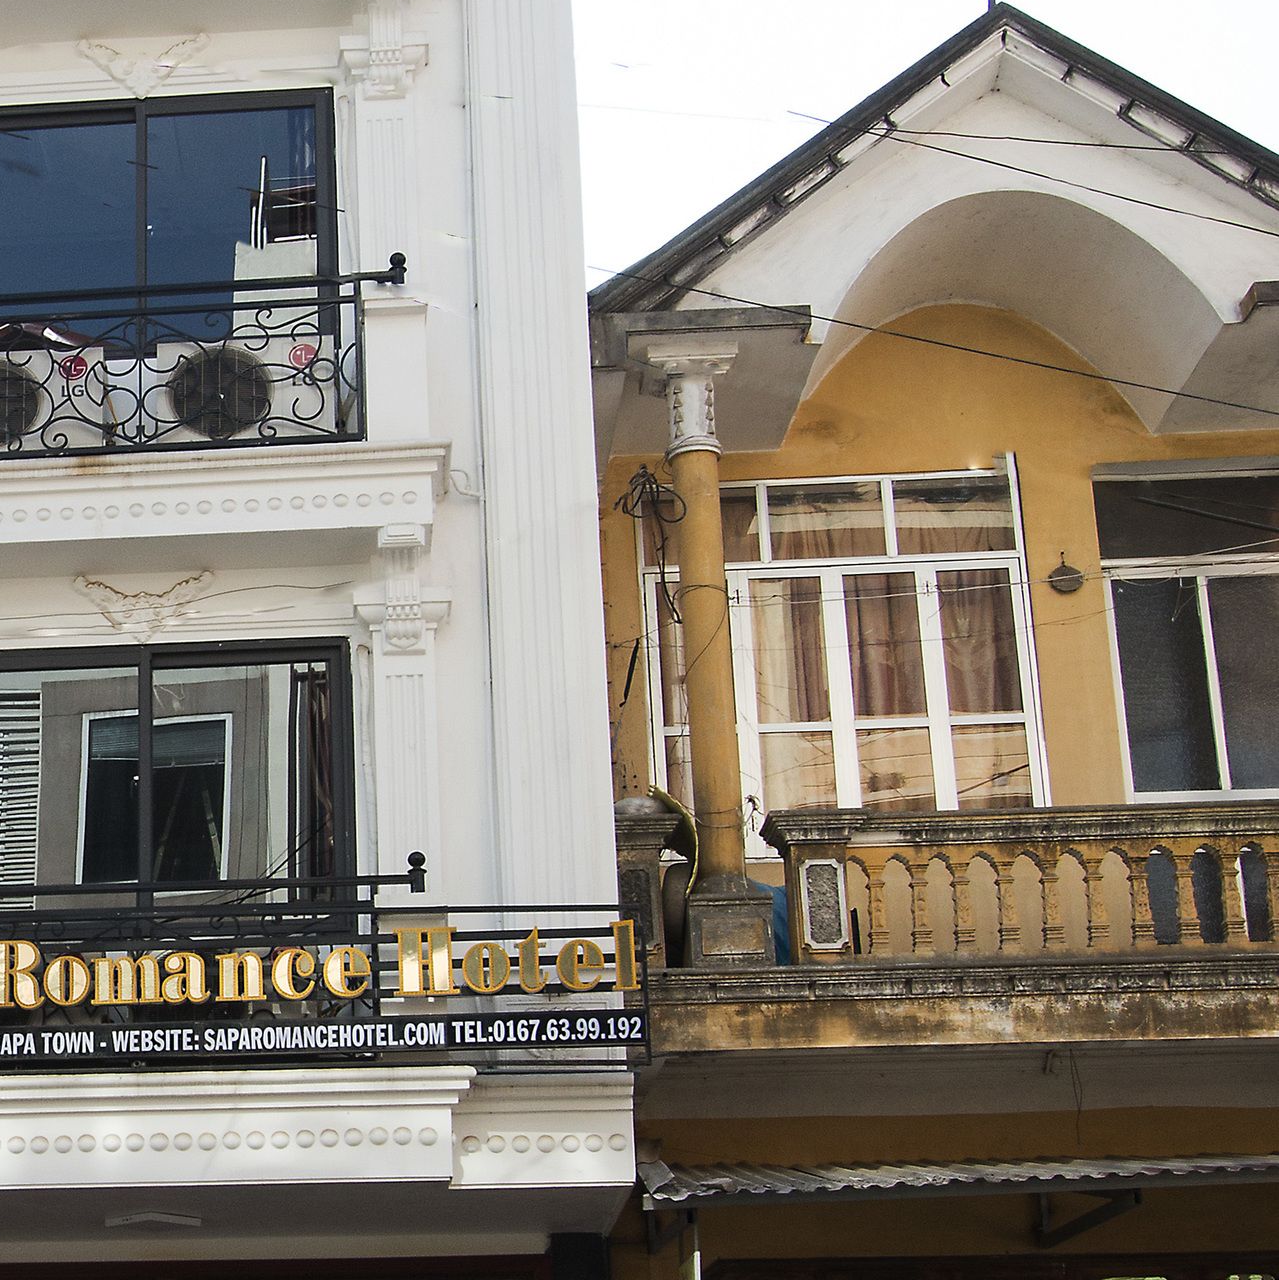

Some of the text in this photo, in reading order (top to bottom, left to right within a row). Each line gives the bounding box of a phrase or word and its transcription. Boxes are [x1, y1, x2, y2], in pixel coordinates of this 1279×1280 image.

[61, 384, 85, 398] LG
[393, 919, 641, 997] Hotel
[41, 1032, 95, 1055] TOWN
[112, 1028, 200, 1053] WEBSITE:
[203, 1022, 445, 1051] SAPAROMANCEHOTEL.COM
